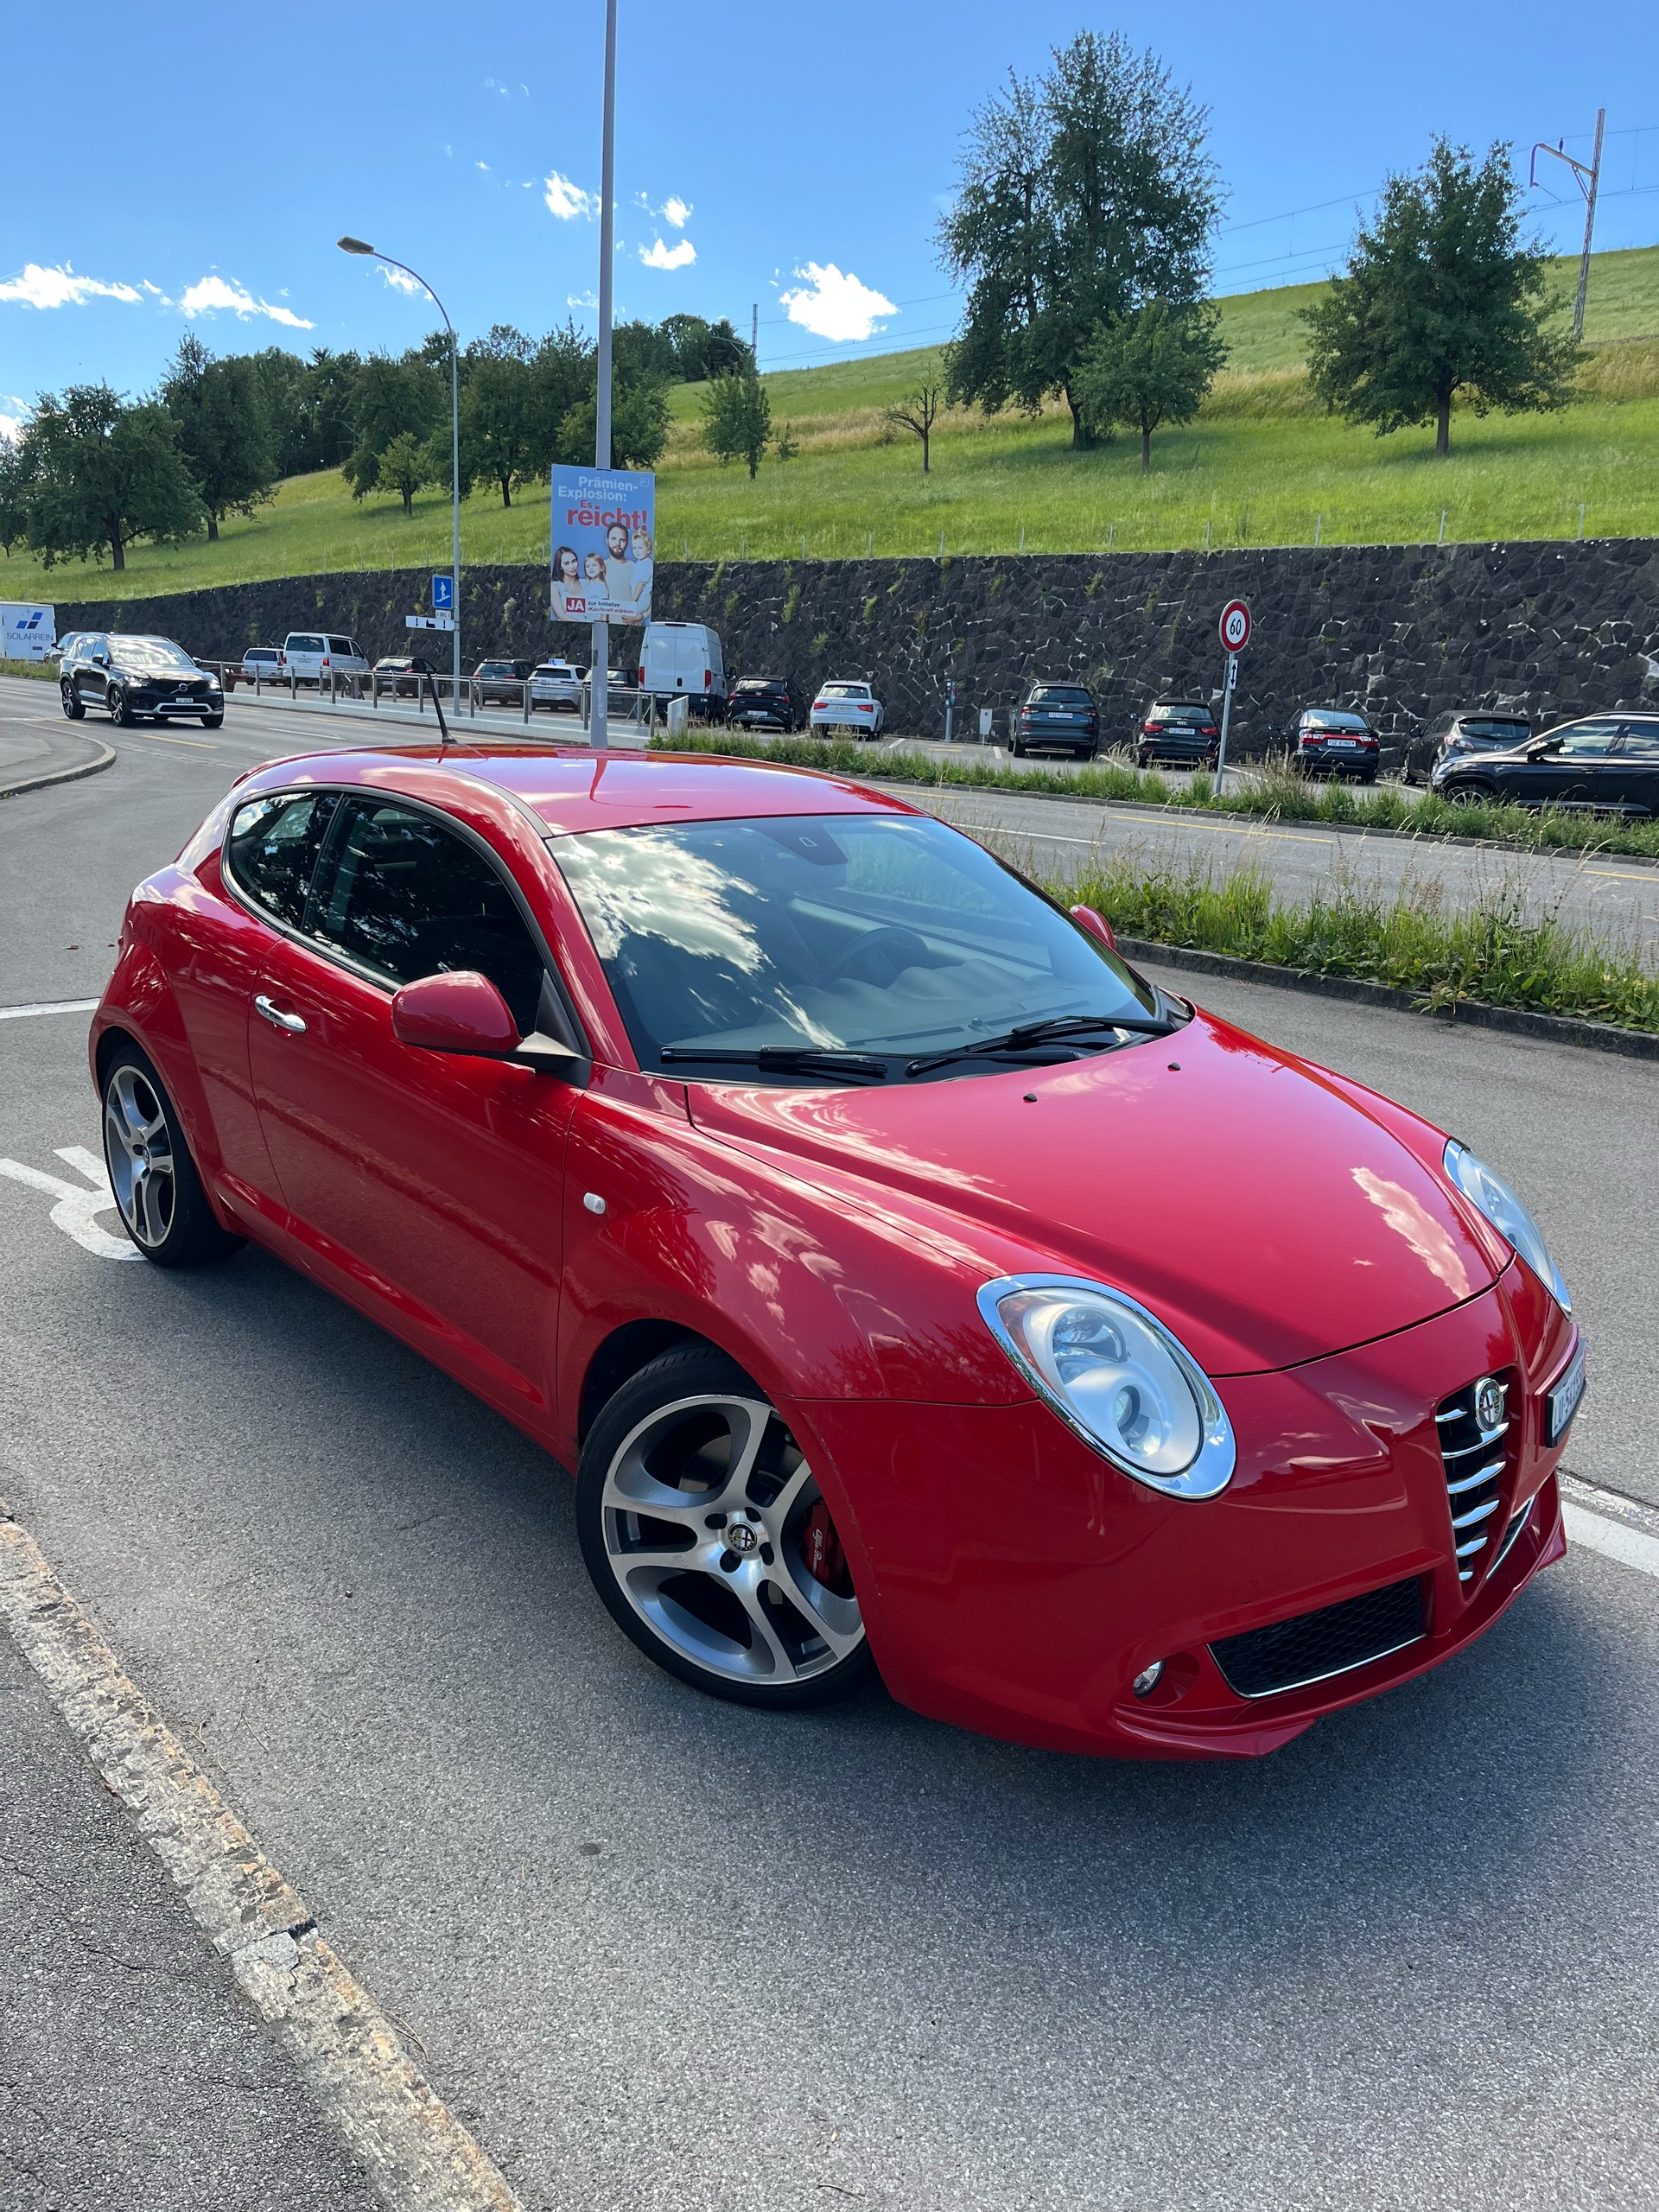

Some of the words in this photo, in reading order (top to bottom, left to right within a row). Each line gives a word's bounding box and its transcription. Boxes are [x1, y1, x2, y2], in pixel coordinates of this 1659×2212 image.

[578, 476, 639, 492] Prämien-
[557, 486, 626, 501] Explosion:
[580, 499, 593, 509] Es
[567, 505, 647, 531] reicht!
[567, 600, 584, 611] JA
[1230, 618, 1242, 636] 60
[7, 632, 54, 641] SOLARREIN
[812, 1529, 823, 1549] Alfa
